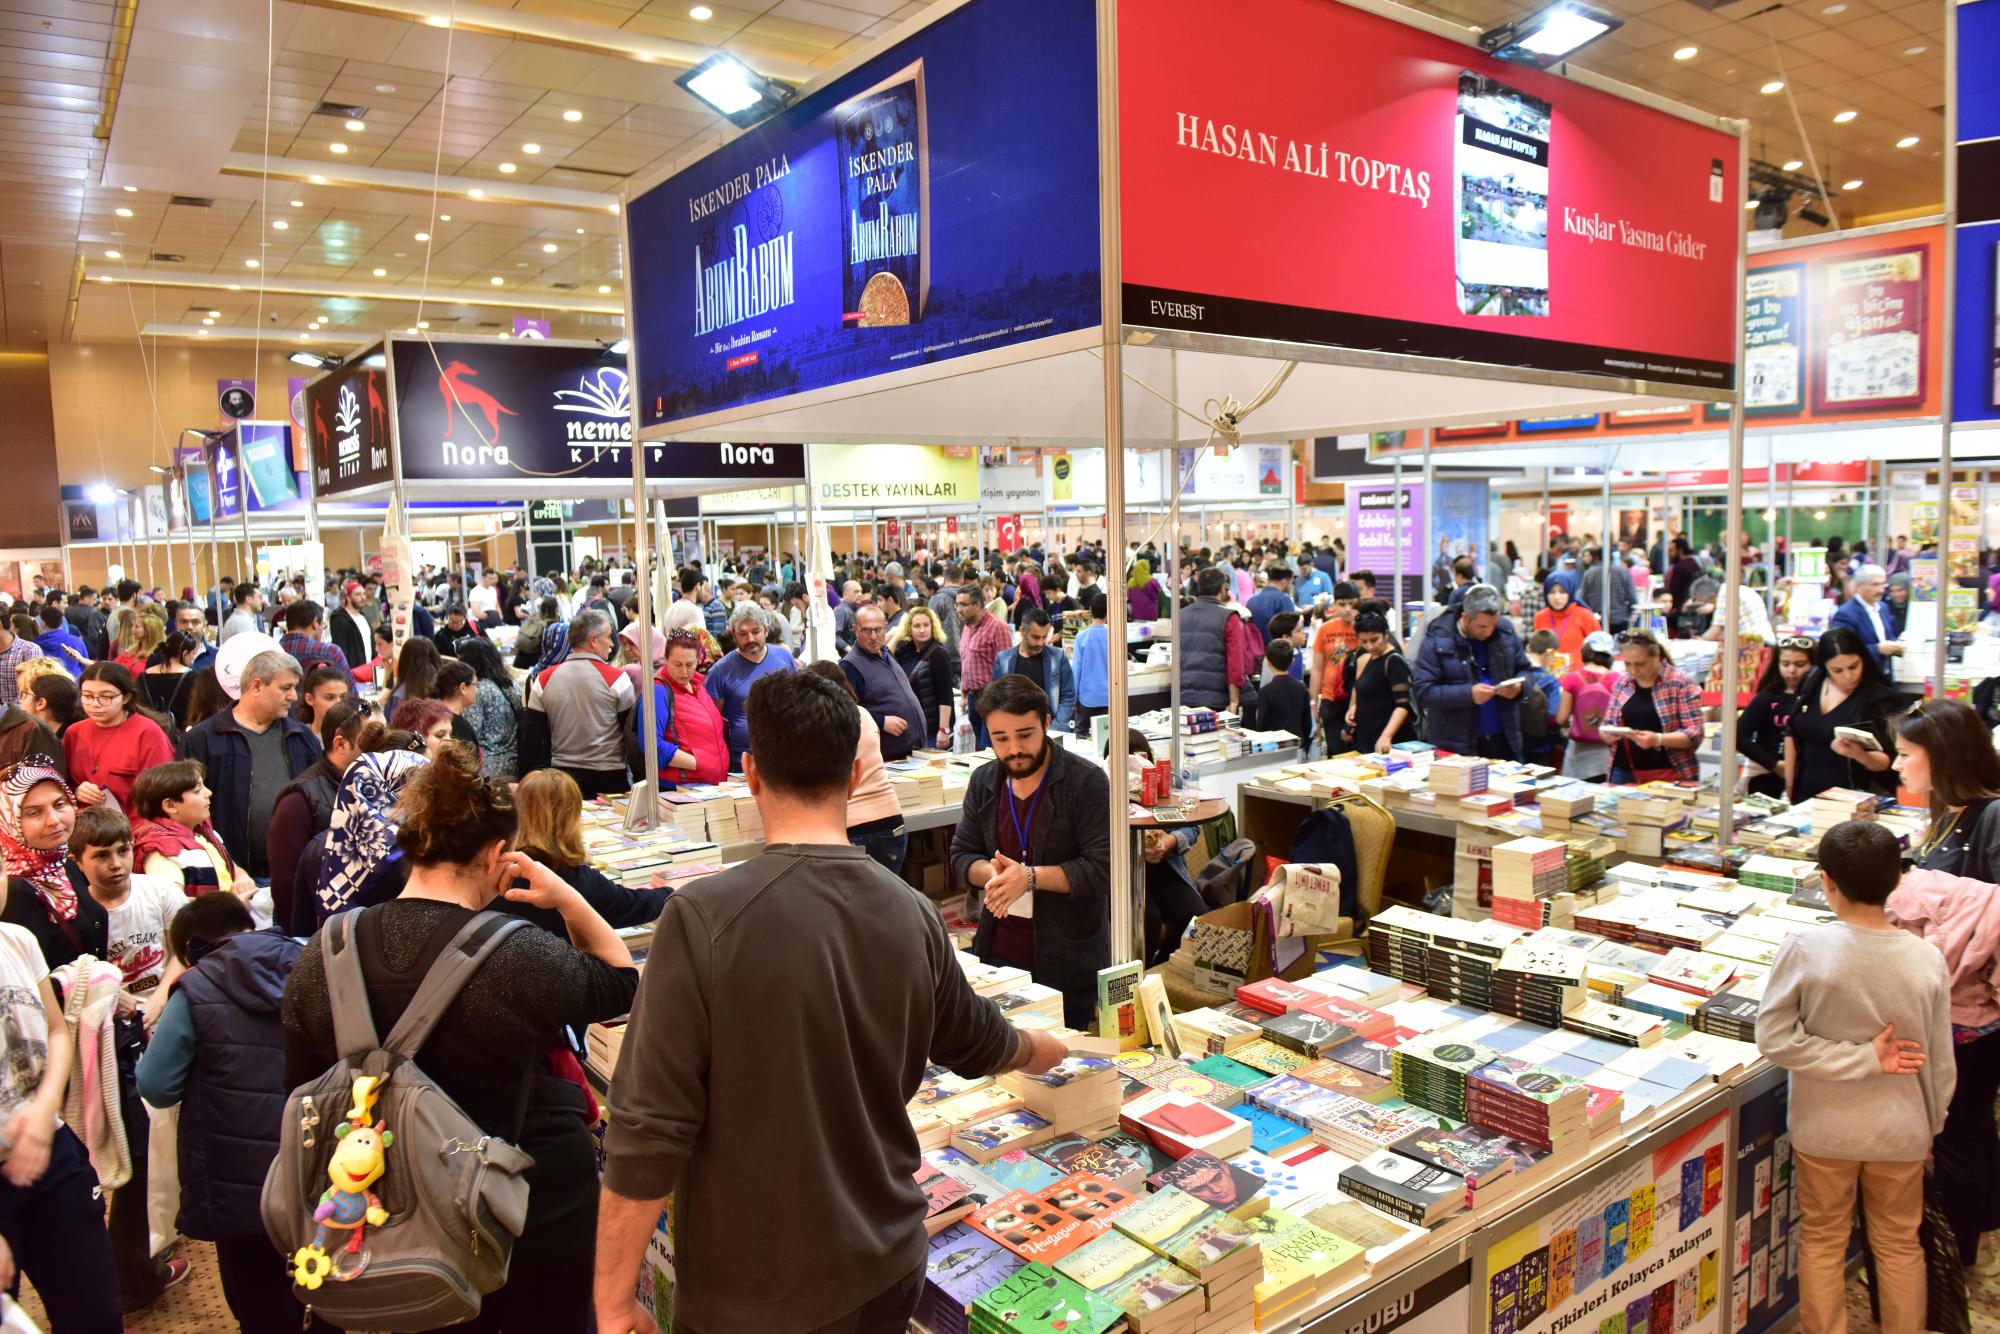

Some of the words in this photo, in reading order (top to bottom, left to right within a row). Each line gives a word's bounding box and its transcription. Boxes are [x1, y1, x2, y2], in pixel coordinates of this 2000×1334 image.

[1475, 128, 1500, 146] HASAN
[849, 141, 914, 178] İSKENDER
[1176, 112, 1278, 167] HASAN
[1283, 141, 1329, 179] ALİ
[1335, 151, 1431, 208] TOPTAŞ
[689, 172, 752, 223] İSKENDER
[755, 153, 791, 189] PALA
[866, 176, 897, 196] PALA
[1563, 206, 1616, 243] Kuşlar
[1618, 219, 1664, 253] Yasına
[1665, 230, 1707, 261] Gider
[730, 334, 751, 349] İbrahim
[822, 483, 880, 498] DESTEK
[884, 482, 957, 497] YAYINLARI
[128, 932, 157, 945] TEAM
[1108, 972, 1139, 991] YOLDA
[1060, 1173, 1086, 1189] AYDIN
[998, 1193, 1024, 1209] AYDIN
[1376, 1201, 1392, 1215] KAYDA
[1392, 1208, 1410, 1223] GEÇSİN
[1378, 1190, 1395, 1204] KAYDA
[1395, 1197, 1413, 1212] GEÇSİN
[1272, 1230, 1317, 1259] FRANZ
[1288, 1236, 1334, 1263] KAFKA
[1551, 1291, 1607, 1334] Fikirleri
[1610, 1258, 1664, 1302] Kolayca
[1668, 1226, 1713, 1263] Anlayın
